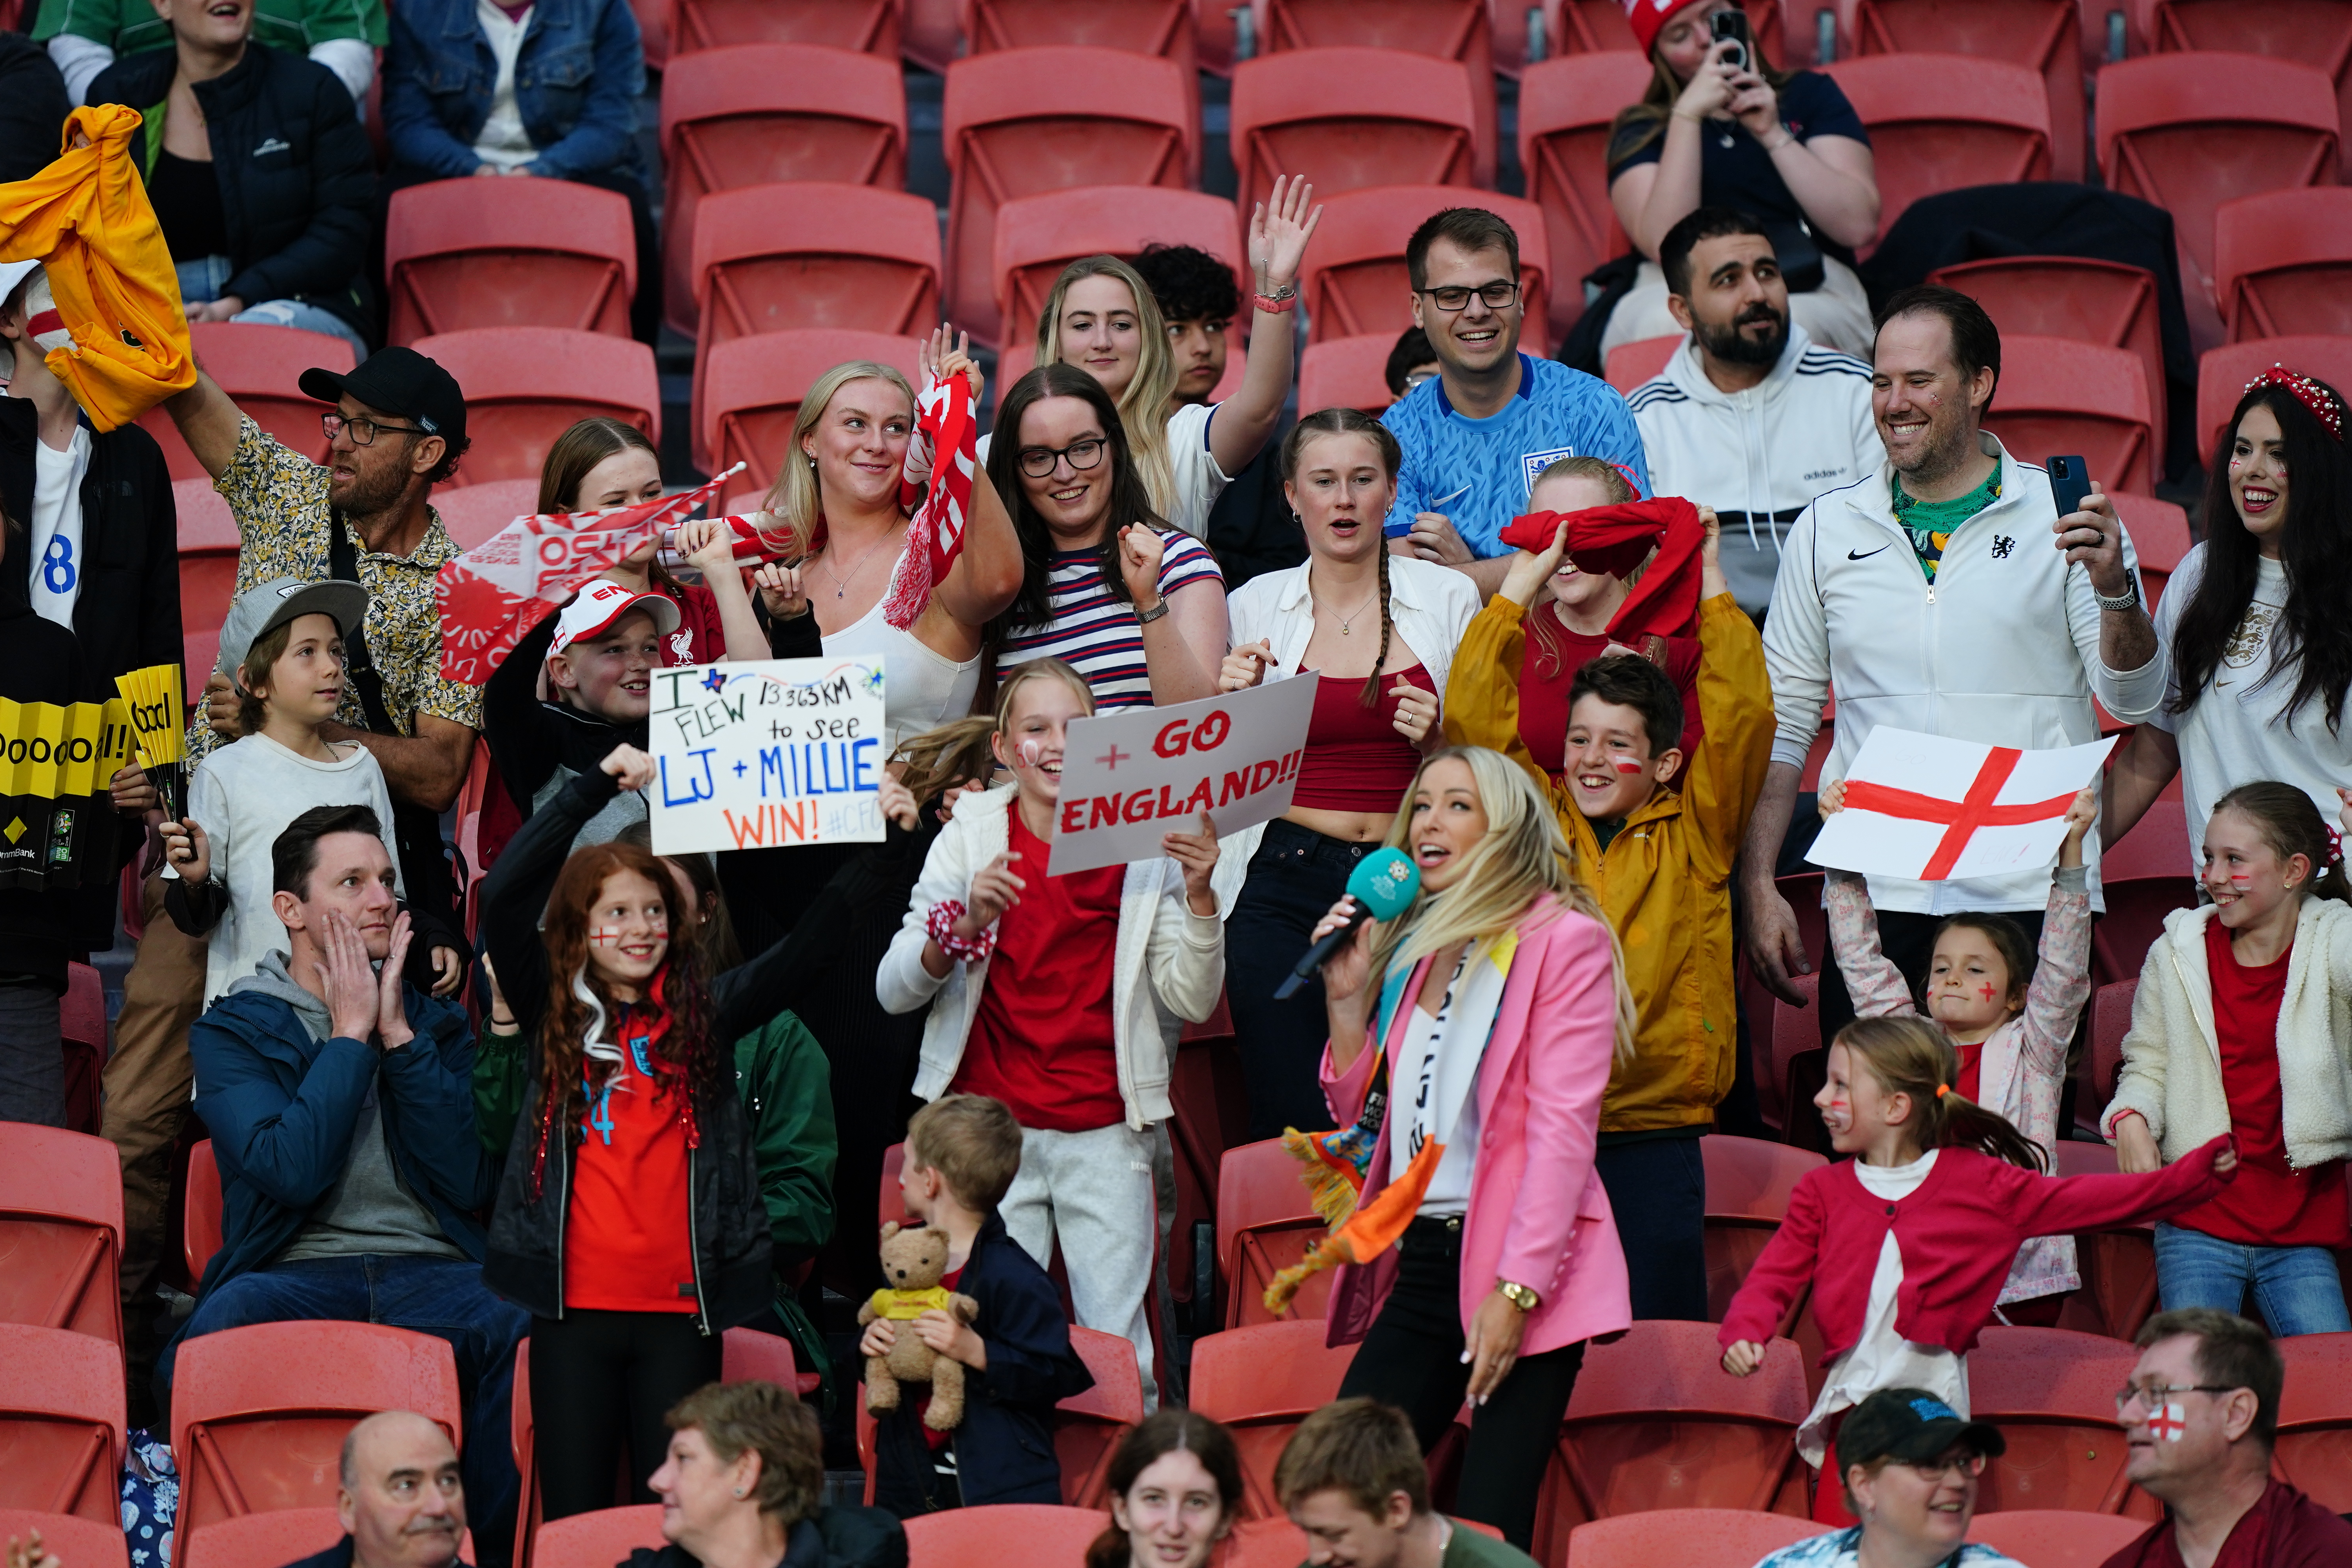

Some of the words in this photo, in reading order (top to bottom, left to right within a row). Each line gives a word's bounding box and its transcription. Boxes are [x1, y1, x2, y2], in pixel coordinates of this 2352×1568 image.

[421, 421, 432, 432] TRADE
[1804, 470, 1837, 480] adidas
[43, 534, 76, 594] 8
[653, 670, 697, 714] I
[675, 693, 745, 746] FLEW
[769, 719, 792, 740] to
[806, 718, 859, 740] see
[1151, 710, 1231, 759] GO
[660, 748, 716, 808] LJ
[733, 760, 747, 778] +
[759, 738, 879, 797] MILLIE
[1060, 749, 1303, 834] ENGLAND!!
[723, 800, 818, 850] WIN!
[0, 848, 35, 860] mmBank
